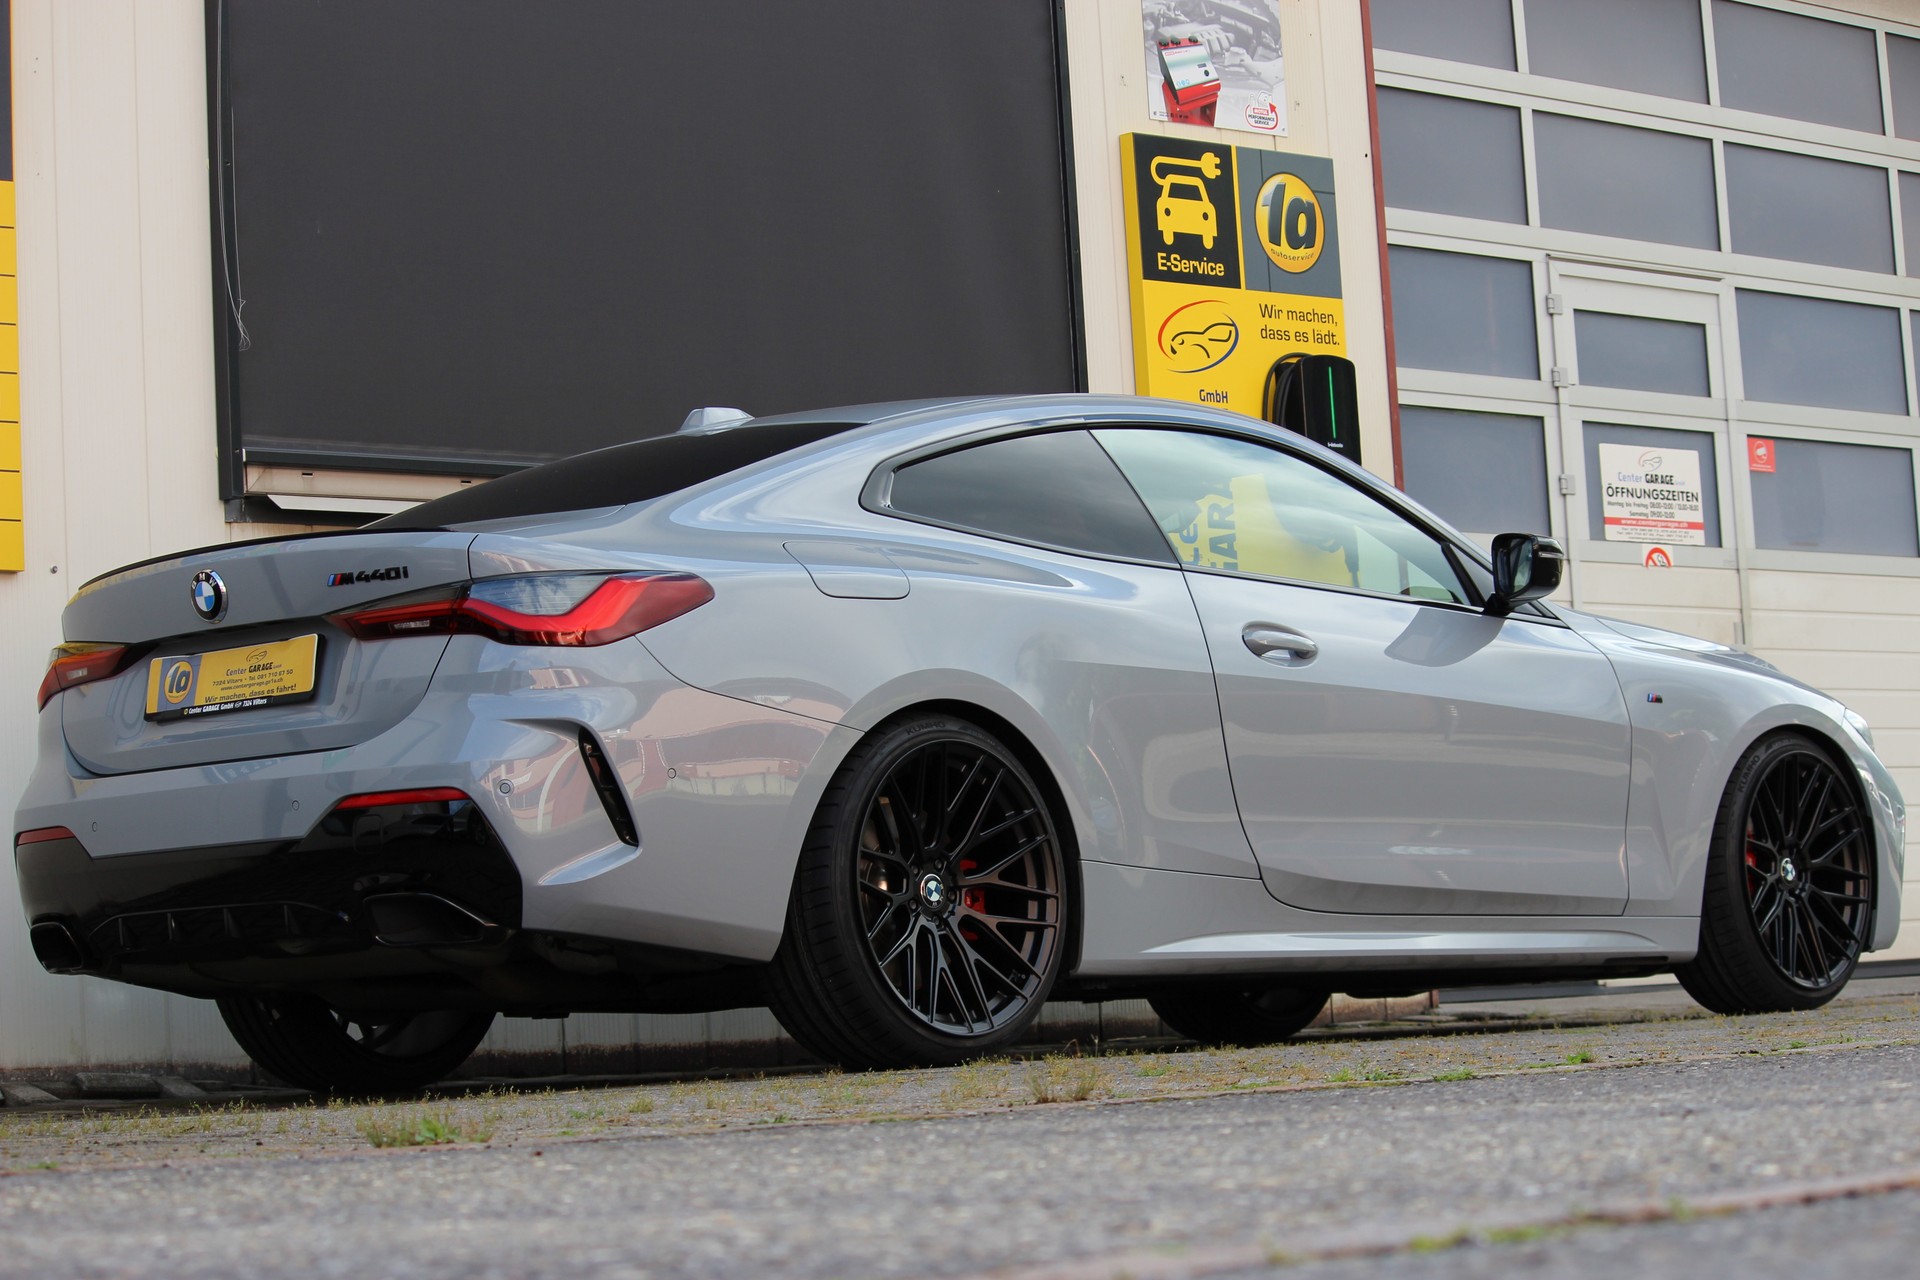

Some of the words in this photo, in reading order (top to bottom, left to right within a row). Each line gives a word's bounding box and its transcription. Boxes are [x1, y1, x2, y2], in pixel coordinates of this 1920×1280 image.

[1248, 114, 1275, 122] PERFORMANCE
[1270, 248, 1315, 262] autoservice
[1157, 252, 1225, 276] E-Service
[1258, 303, 1283, 320] Wir
[1286, 307, 1338, 327] machen,
[1260, 325, 1291, 342] dass
[1294, 331, 1309, 344] es
[1312, 329, 1340, 346] lädt.
[1199, 389, 1229, 404] GmbH
[1618, 471, 1643, 483] Center
[1645, 473, 1674, 485] GARAGE
[1606, 483, 1699, 502] ÖFFNUNGSZEITEN
[1621, 519, 1688, 528] www.centergarage.ch
[340, 566, 409, 585] M440i
[226, 668, 247, 677] Center
[249, 662, 273, 673] GARAGE
[205, 695, 219, 703] Wir
[219, 692, 248, 701] machen,
[249, 689, 265, 698] dass
[266, 688, 275, 696] es
[276, 684, 297, 694] fährt!
[188, 706, 202, 715] Center
[202, 704, 220, 713] GARAGE
[220, 702, 234, 711] GmbH
[242, 700, 253, 708] 7324
[253, 698, 267, 707] Vilters
[905, 722, 946, 736] KUMHO
[1738, 755, 1760, 793] KUMHO
